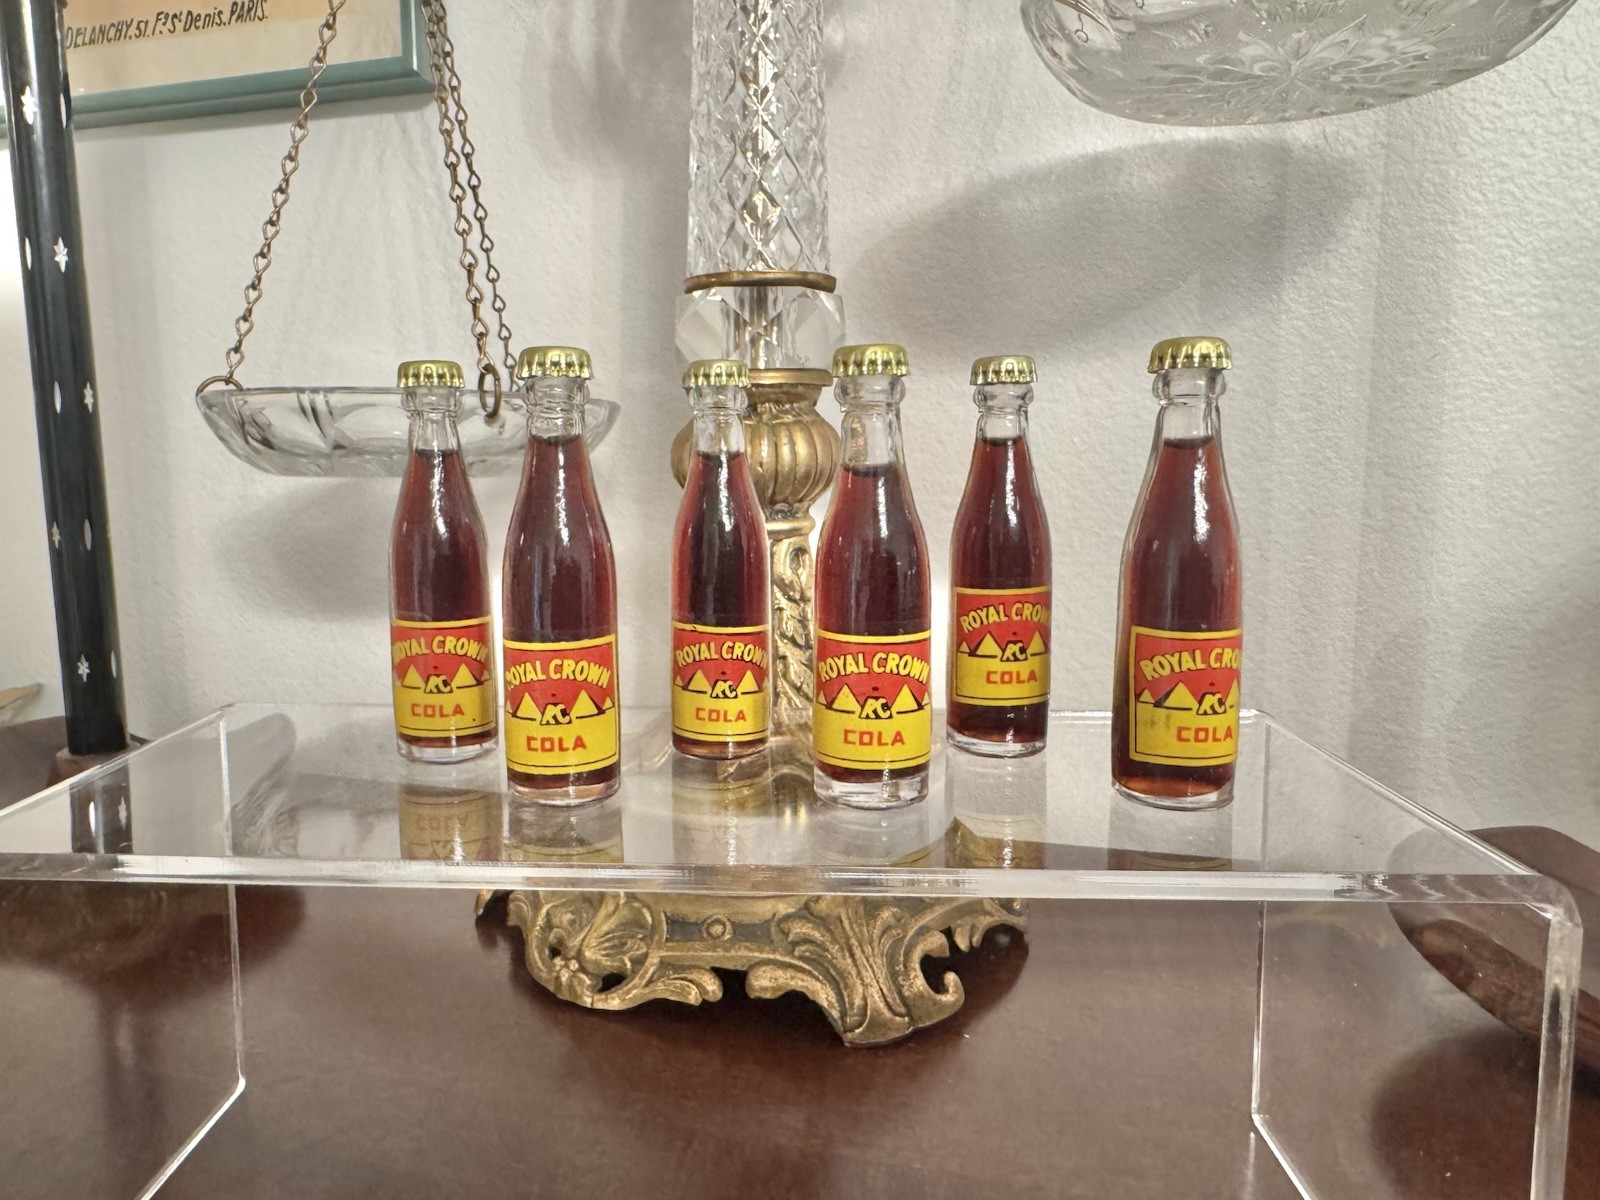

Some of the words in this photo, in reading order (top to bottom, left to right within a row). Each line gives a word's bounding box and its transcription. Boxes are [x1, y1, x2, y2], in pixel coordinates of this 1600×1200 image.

[960, 604, 1008, 634] ROYAL
[1011, 602, 1049, 626] CROW
[432, 636, 489, 662] CROWN
[676, 641, 719, 667] ROYAL
[1001, 642, 1027, 661] RC
[549, 658, 611, 689] CROWN
[819, 653, 870, 683] ROYAL
[872, 652, 930, 684] CROWN
[1139, 649, 1206, 681] ROYAL
[1209, 647, 1240, 669] CRO
[424, 675, 452, 693] RC
[985, 669, 1037, 685] COLA
[711, 680, 737, 698] RC
[411, 703, 465, 718] COLA
[541, 703, 571, 725] RC
[860, 697, 891, 719] RC
[1197, 693, 1226, 715] RC
[695, 707, 747, 723] COLA
[526, 735, 587, 753] COLA
[843, 729, 905, 747] COLA
[1176, 725, 1233, 743] COLA
